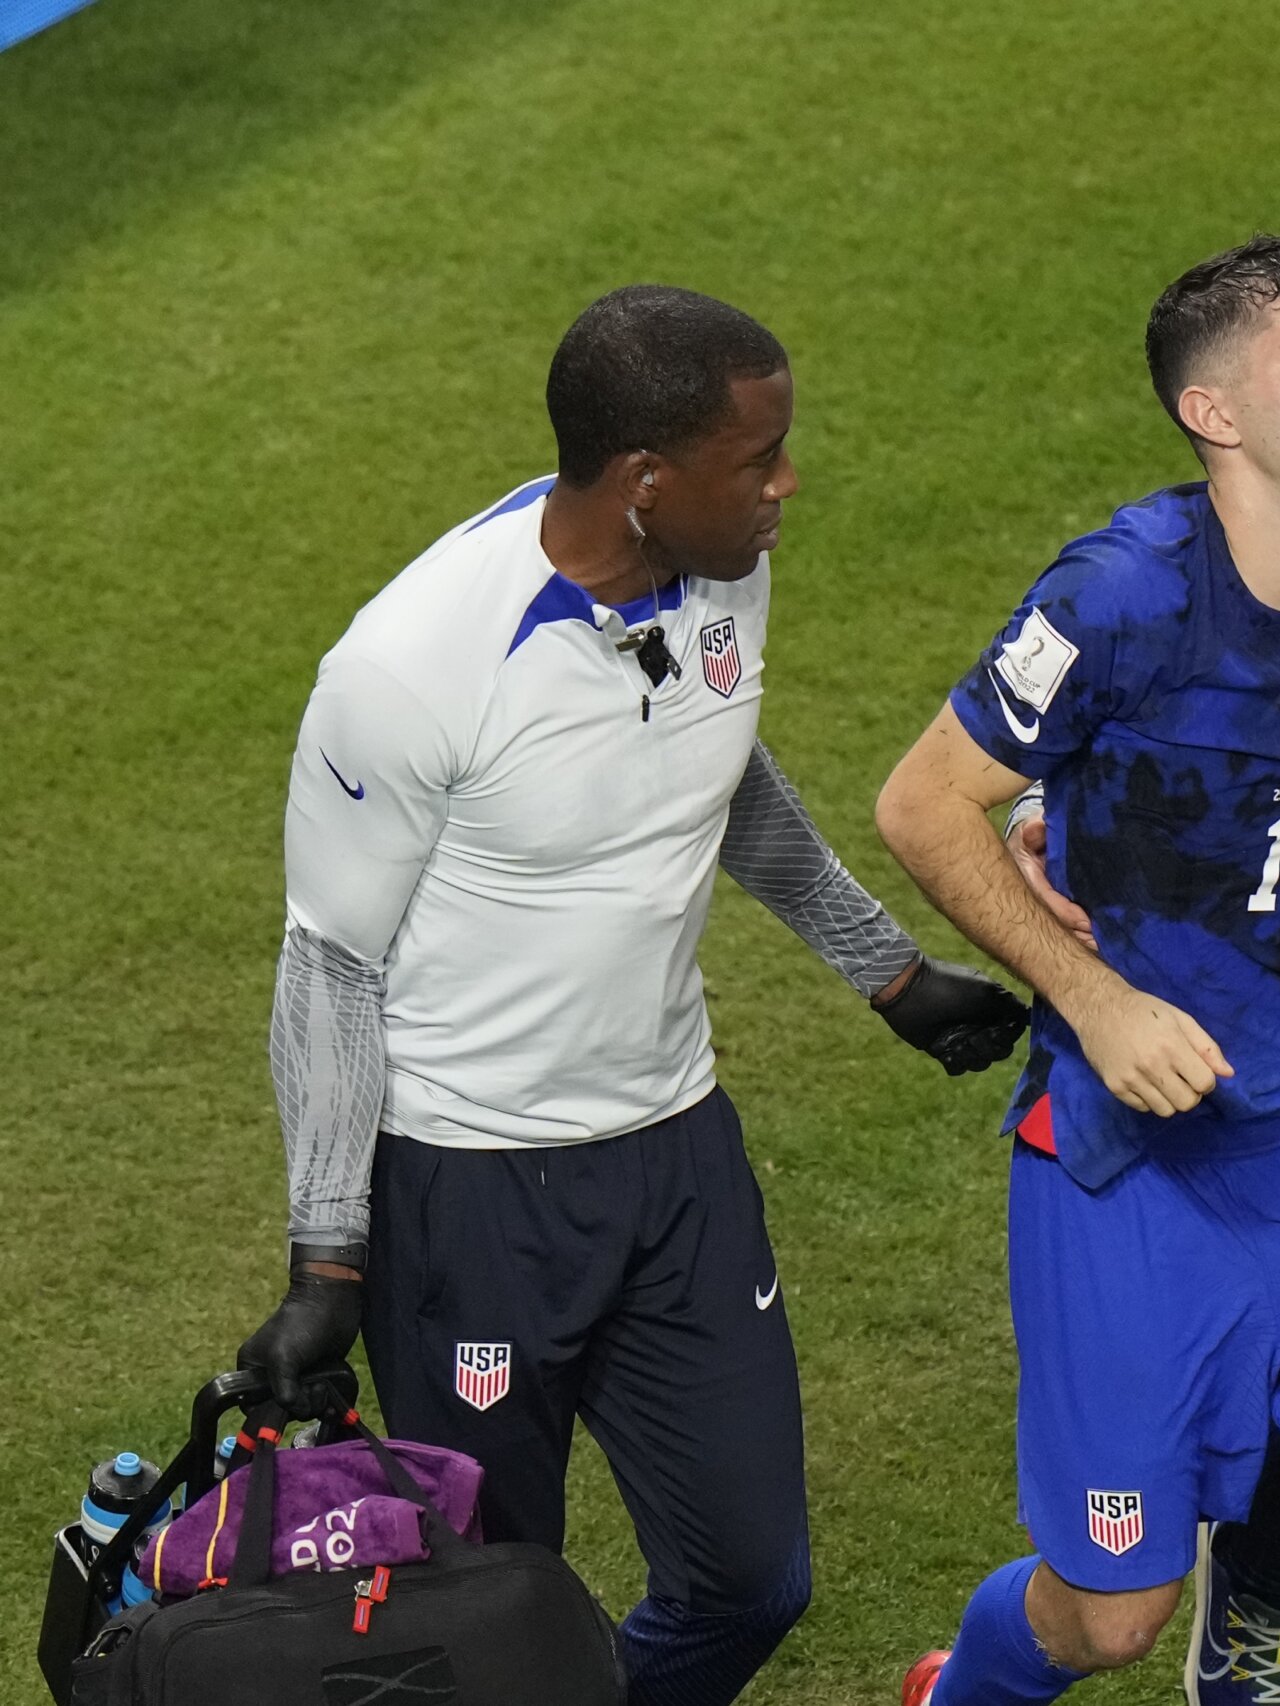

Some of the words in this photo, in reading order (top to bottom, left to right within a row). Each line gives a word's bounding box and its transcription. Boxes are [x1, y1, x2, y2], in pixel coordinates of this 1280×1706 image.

[704, 625, 732, 655] USA
[460, 1346, 508, 1372] USA
[1091, 1494, 1138, 1519] USA
